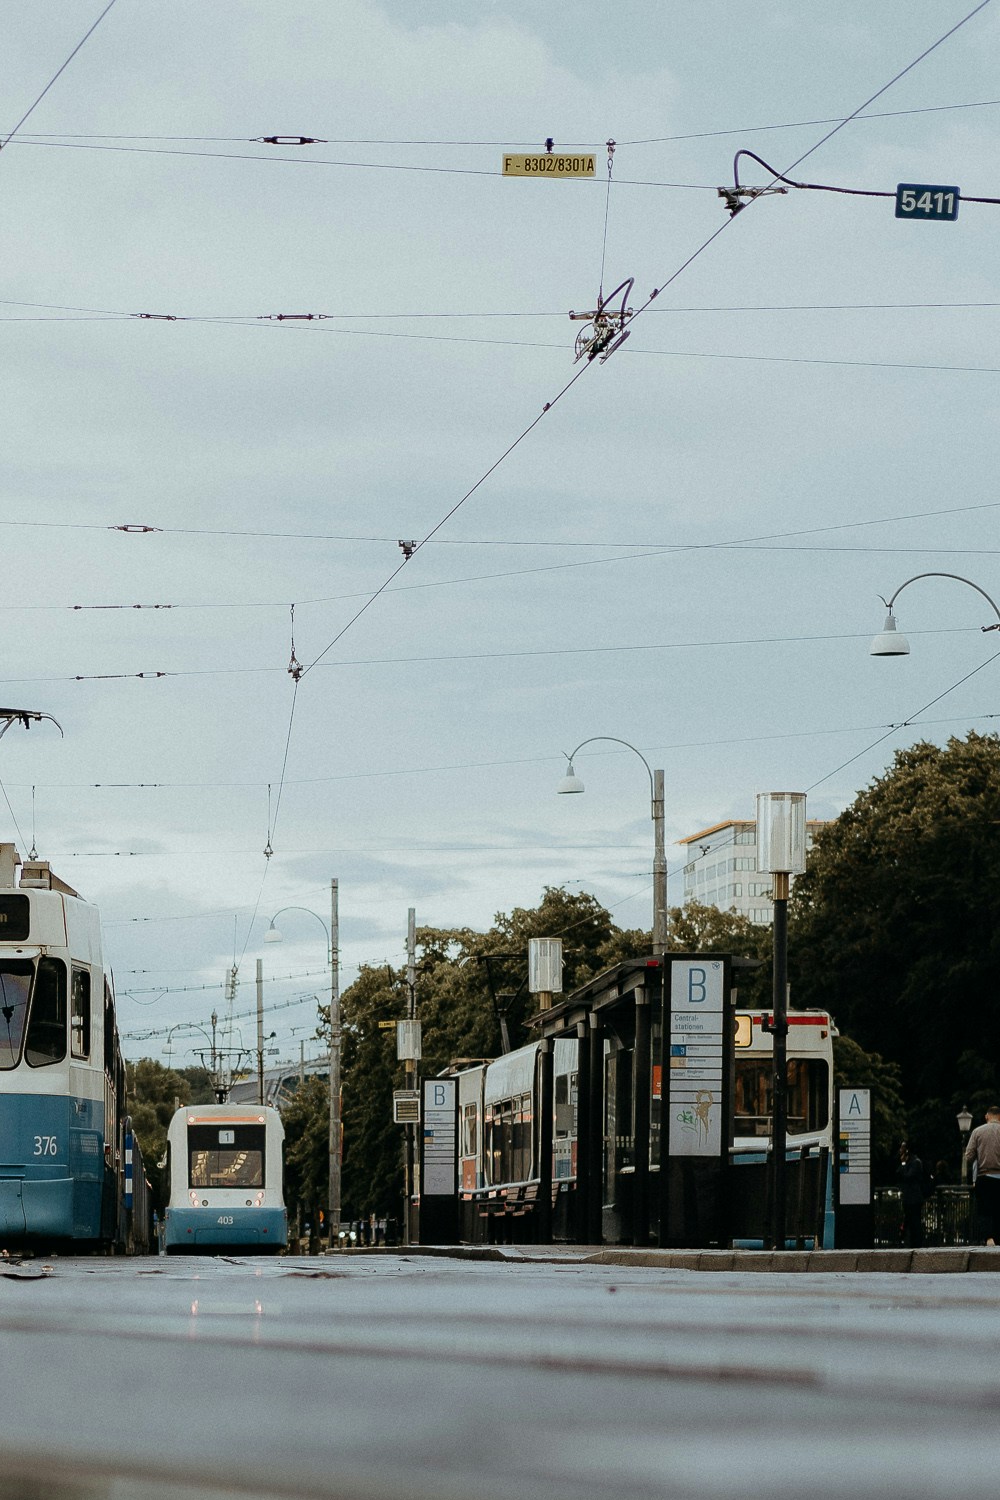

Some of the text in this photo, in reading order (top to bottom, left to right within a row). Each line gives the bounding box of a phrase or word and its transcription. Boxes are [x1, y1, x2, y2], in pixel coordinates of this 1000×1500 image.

[505, 158, 512, 172] F
[524, 158, 594, 172] 8302/8301A
[901, 190, 955, 214] 5411
[688, 967, 706, 1003] B
[674, 1014, 699, 1022] Central-
[680, 1047, 685, 1055] 3
[434, 1085, 445, 1106] B
[848, 1093, 861, 1115] A
[33, 1135, 58, 1156] 376
[224, 1132, 230, 1142] 1
[217, 1216, 234, 1225] 403
